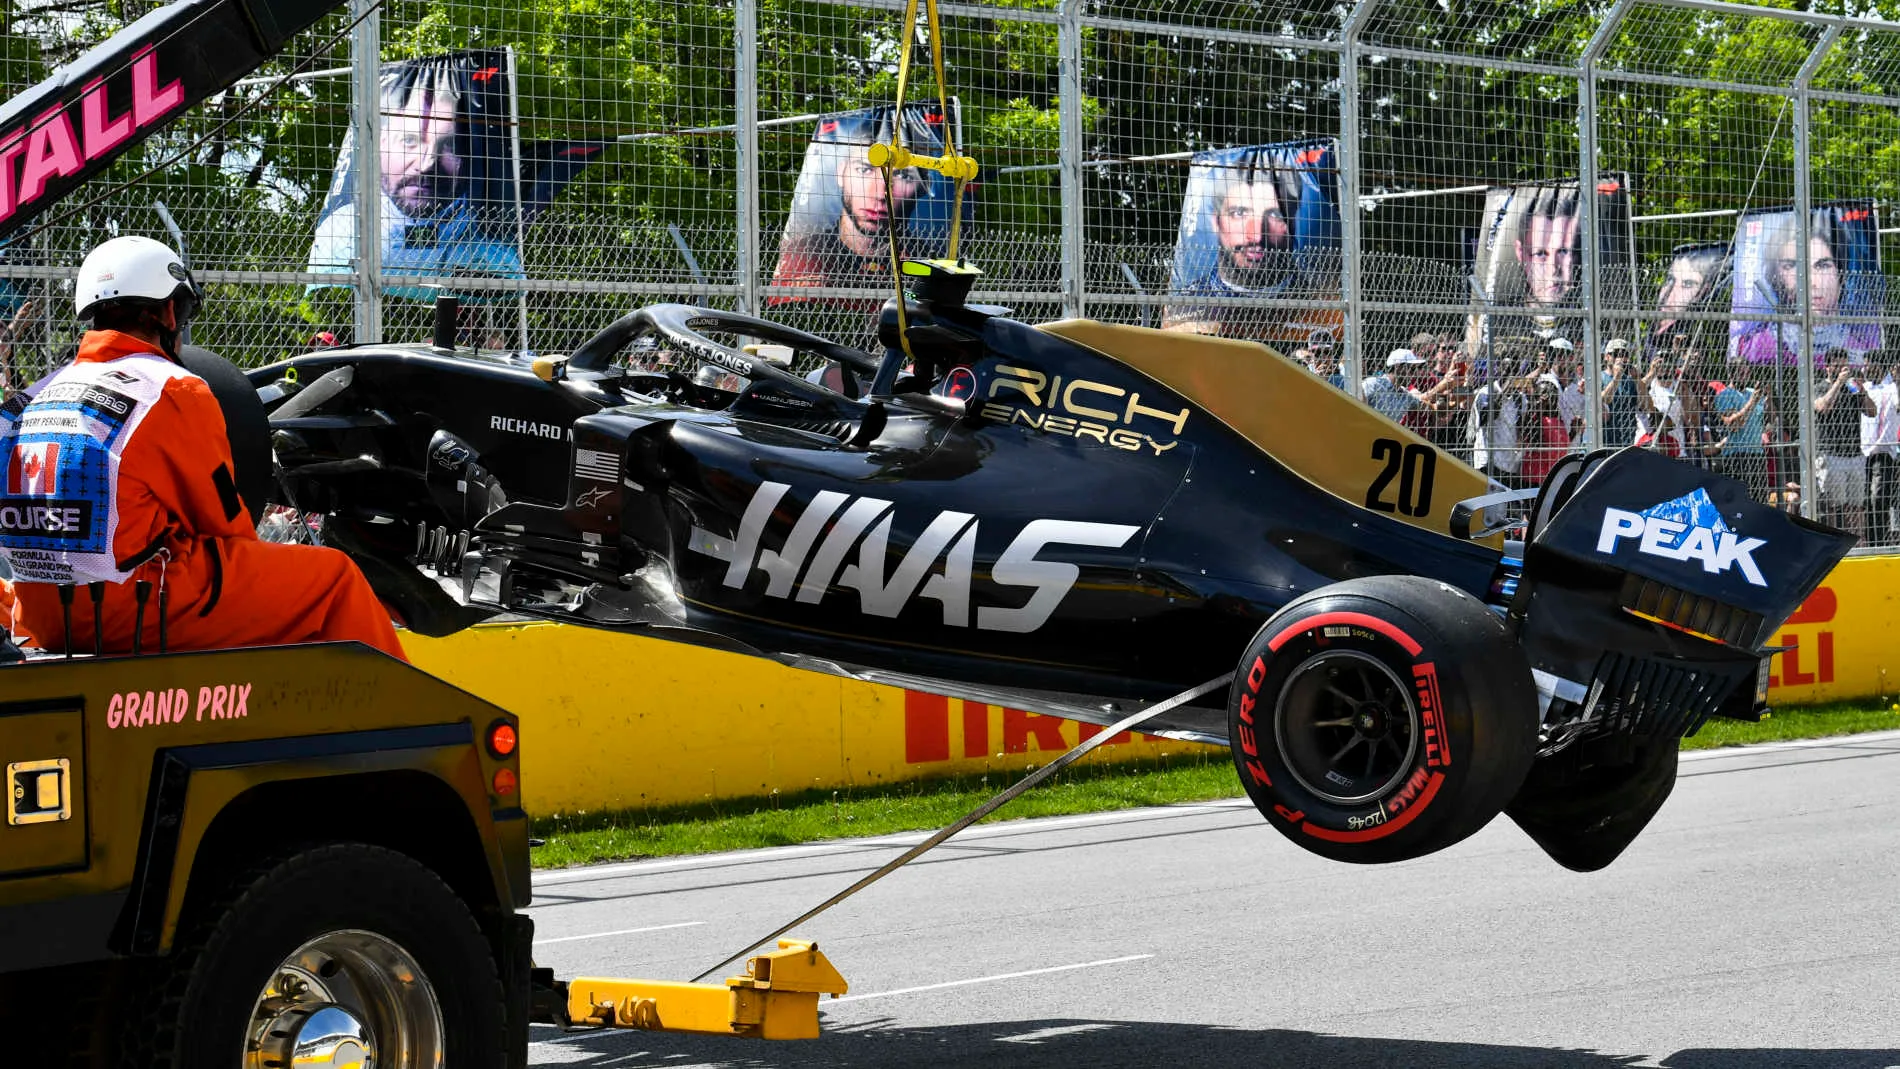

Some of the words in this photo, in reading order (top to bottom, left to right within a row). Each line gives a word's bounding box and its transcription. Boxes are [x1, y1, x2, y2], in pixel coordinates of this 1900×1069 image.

[83, 388, 128, 414] 2019
[490, 415, 561, 440] RICHARD
[759, 394, 813, 408] MAGNUSSEN
[980, 403, 1178, 456] ENERGY
[988, 364, 1190, 435] RICH
[1365, 438, 1437, 518] 20
[11, 550, 51, 561] FORMULA
[688, 480, 1141, 633] HAAS
[1596, 507, 1768, 587] PEAK
[107, 688, 188, 729] GRAND
[196, 683, 251, 722] PRIX
[1238, 656, 1272, 787] ZERO
[1412, 662, 1451, 766] PIRELLI
